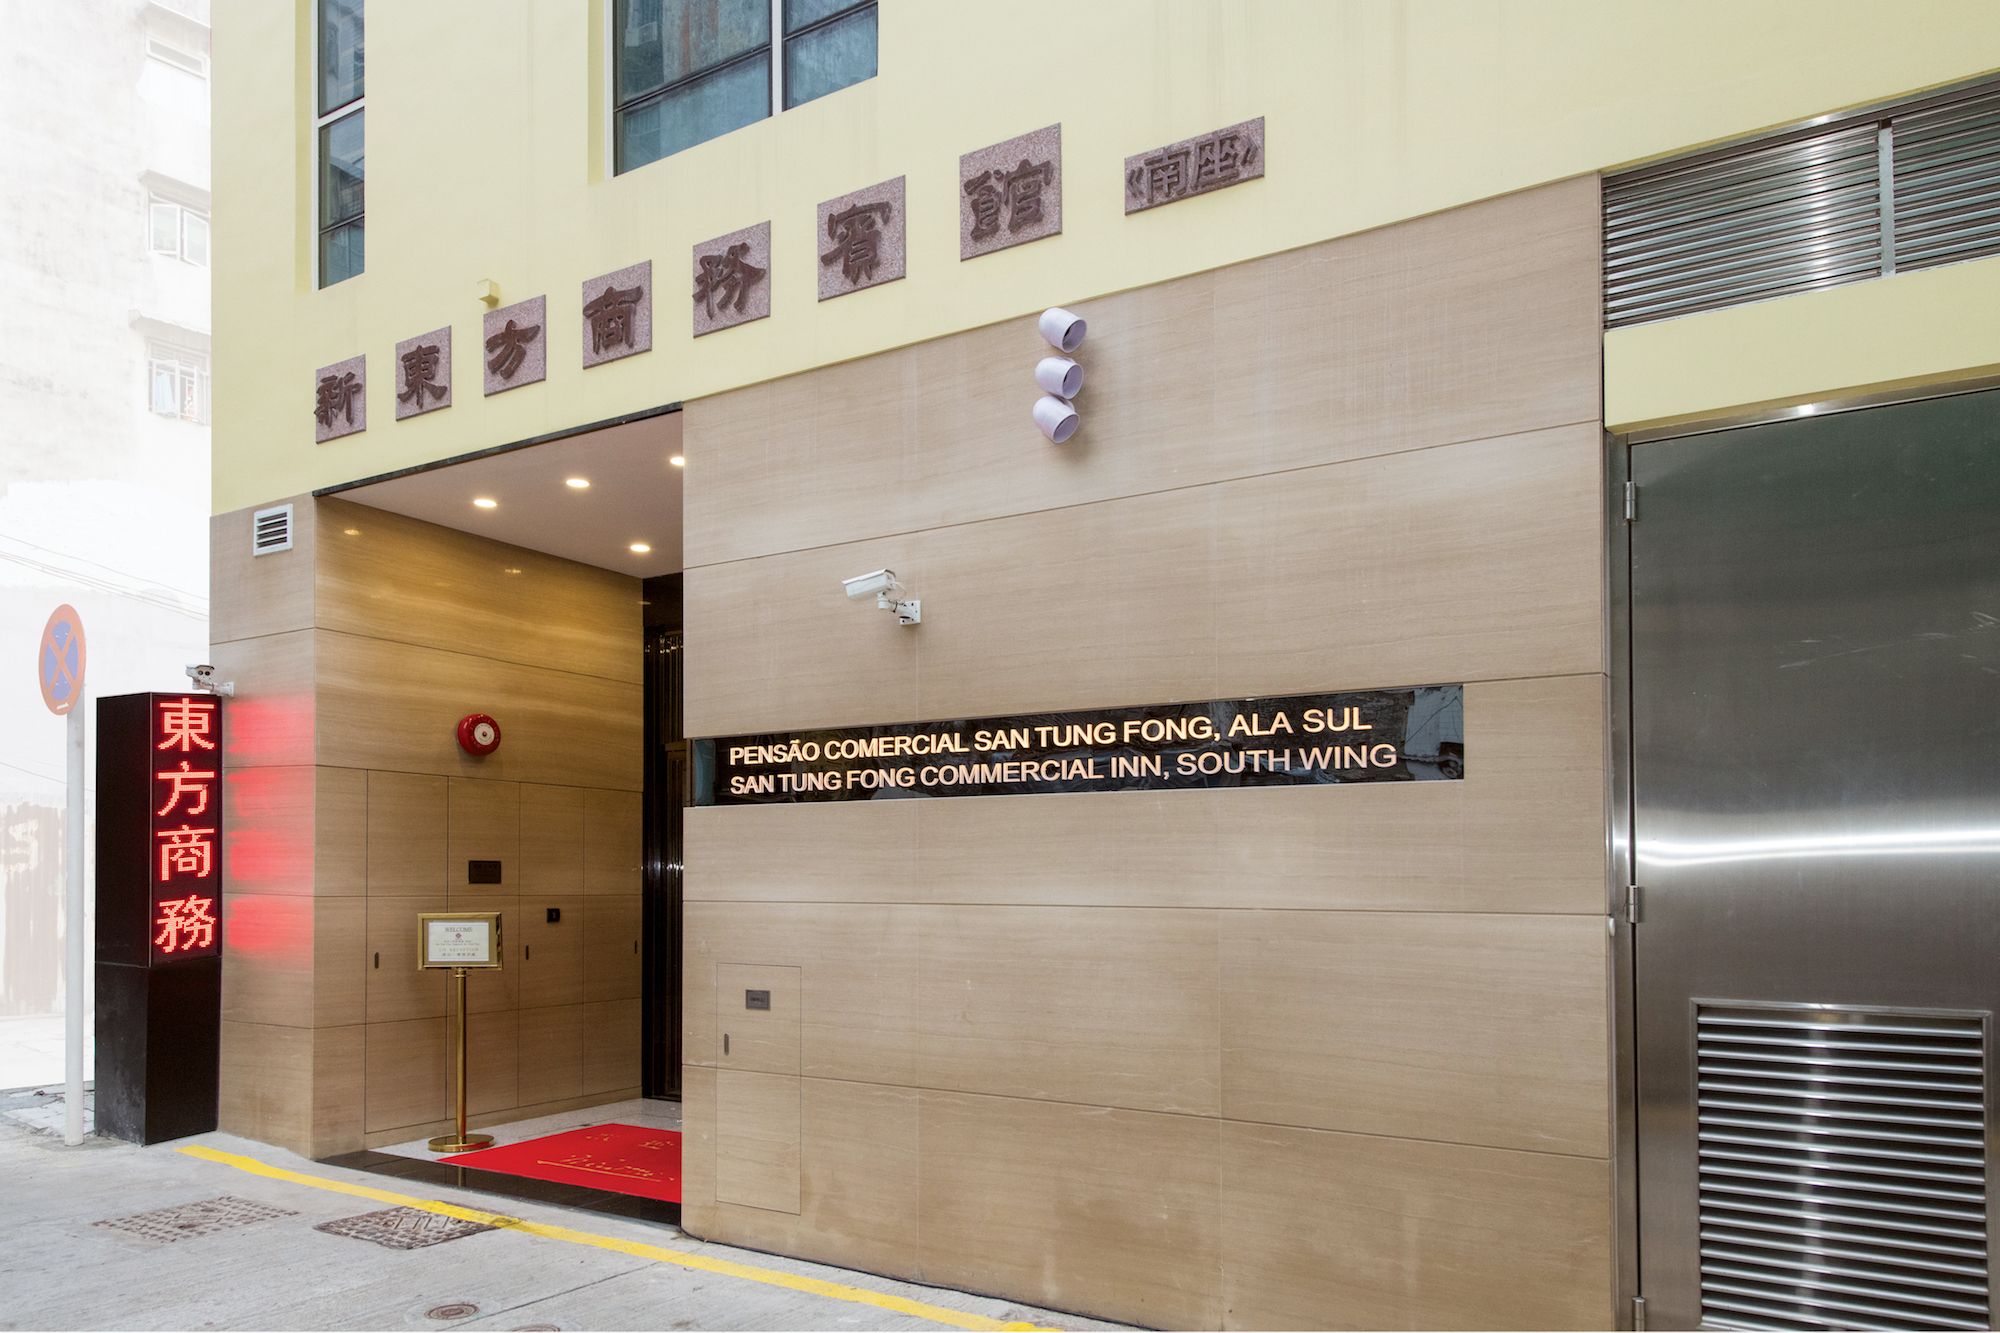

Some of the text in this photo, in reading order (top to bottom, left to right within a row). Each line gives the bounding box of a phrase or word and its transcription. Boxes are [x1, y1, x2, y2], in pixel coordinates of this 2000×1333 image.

[314, 158, 1054, 428] 新東方商務賓館
[729, 706, 1373, 766] PENSÃO COMERCIAL SAN TUNG FONG, ALA SUL
[729, 743, 1398, 795] SAN TUNG FONG COMMERCIAL INN, SOUTH WING
[154, 697, 216, 953] 東方商務
